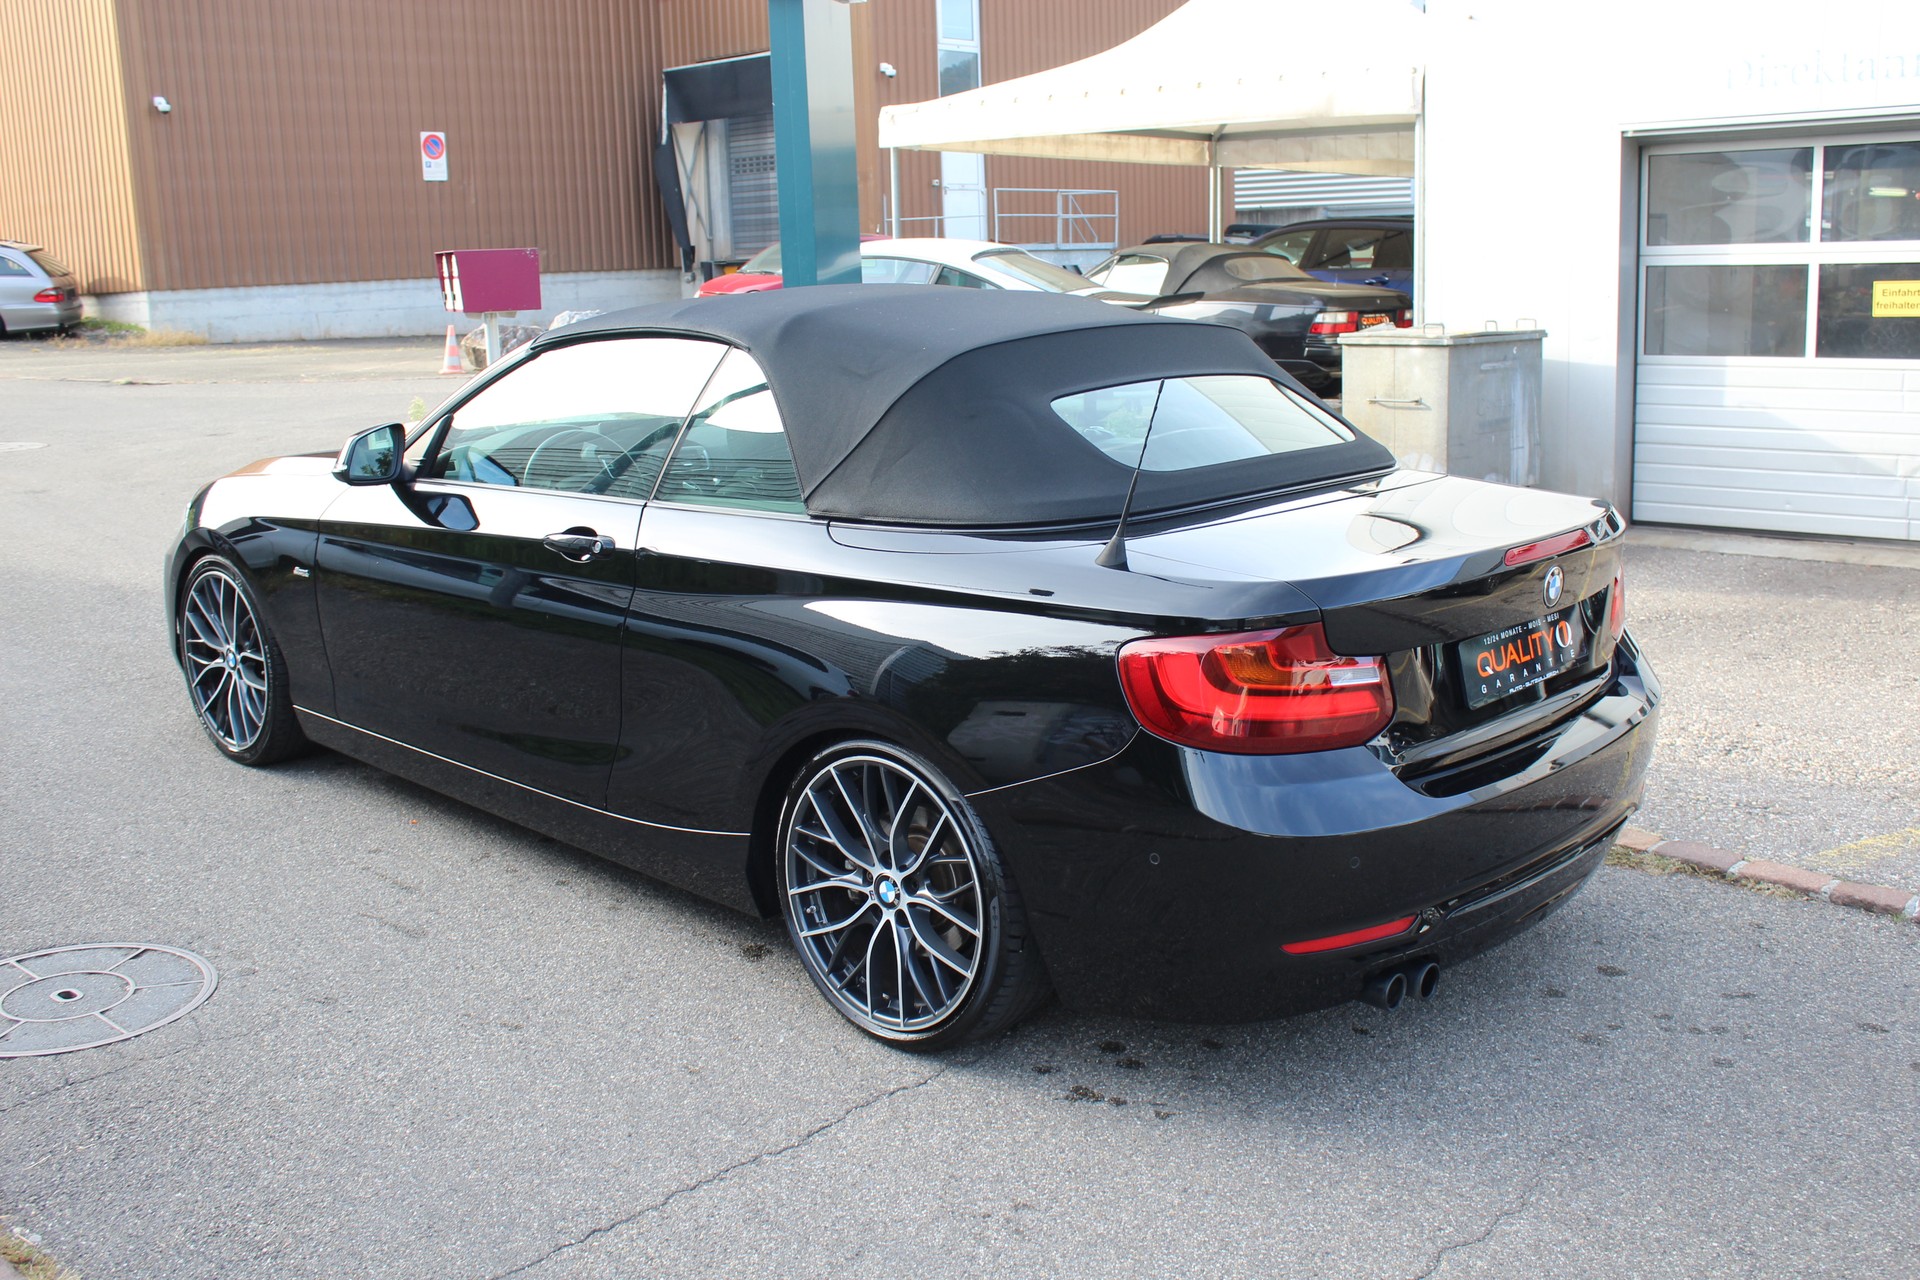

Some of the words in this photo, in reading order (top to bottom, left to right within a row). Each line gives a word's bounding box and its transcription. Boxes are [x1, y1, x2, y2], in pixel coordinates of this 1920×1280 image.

[1483, 633, 1499, 645] 12/24
[1500, 625, 1522, 639] MONATE
[1527, 618, 1541, 629] MOIS
[1546, 612, 1560, 622] MESI
[1481, 650, 1575, 694] GARANTIE
